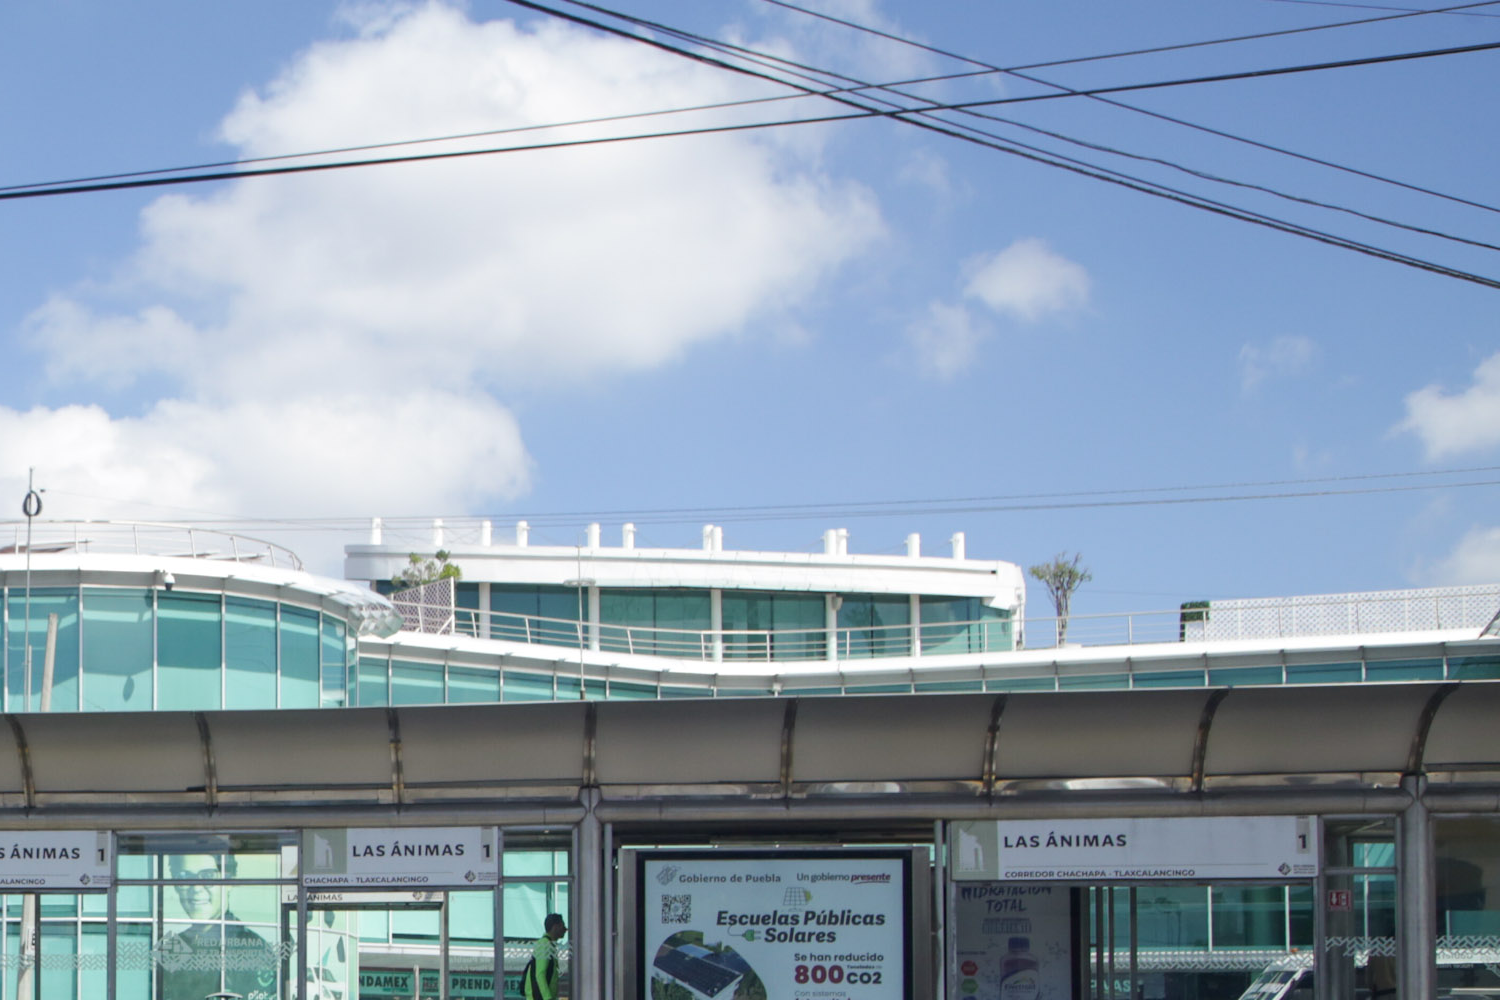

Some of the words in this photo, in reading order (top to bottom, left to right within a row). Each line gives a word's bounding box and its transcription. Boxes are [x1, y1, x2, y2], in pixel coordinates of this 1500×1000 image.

[1004, 835, 1041, 848] LAS
[1046, 831, 1127, 847] ÁNIMAS
[10, 844, 81, 859] ÁNIMAS
[352, 845, 385, 857] LAS
[391, 841, 465, 857] ÁNIMAS
[356, 876, 429, 884] TLAXCALANCINGO
[679, 874, 727, 883] Gobierno
[730, 874, 742, 883] de
[745, 874, 781, 883] Puebla
[796, 873, 809, 881] Un
[810, 872, 850, 884] gobierno
[851, 873, 891, 884] presente
[1005, 870, 1054, 878] CORREDOR
[1056, 870, 1106, 878] CHACHAPA
[1114, 869, 1196, 878] TLAXCALANCINGO
[717, 910, 800, 926] Escuelas
[804, 909, 886, 926] Públicas
[764, 928, 837, 943] Solares
[794, 953, 807, 962] Se
[810, 953, 832, 962] han
[834, 952, 884, 962] reducido
[794, 965, 844, 984] 800
[846, 972, 882, 985] CO2
